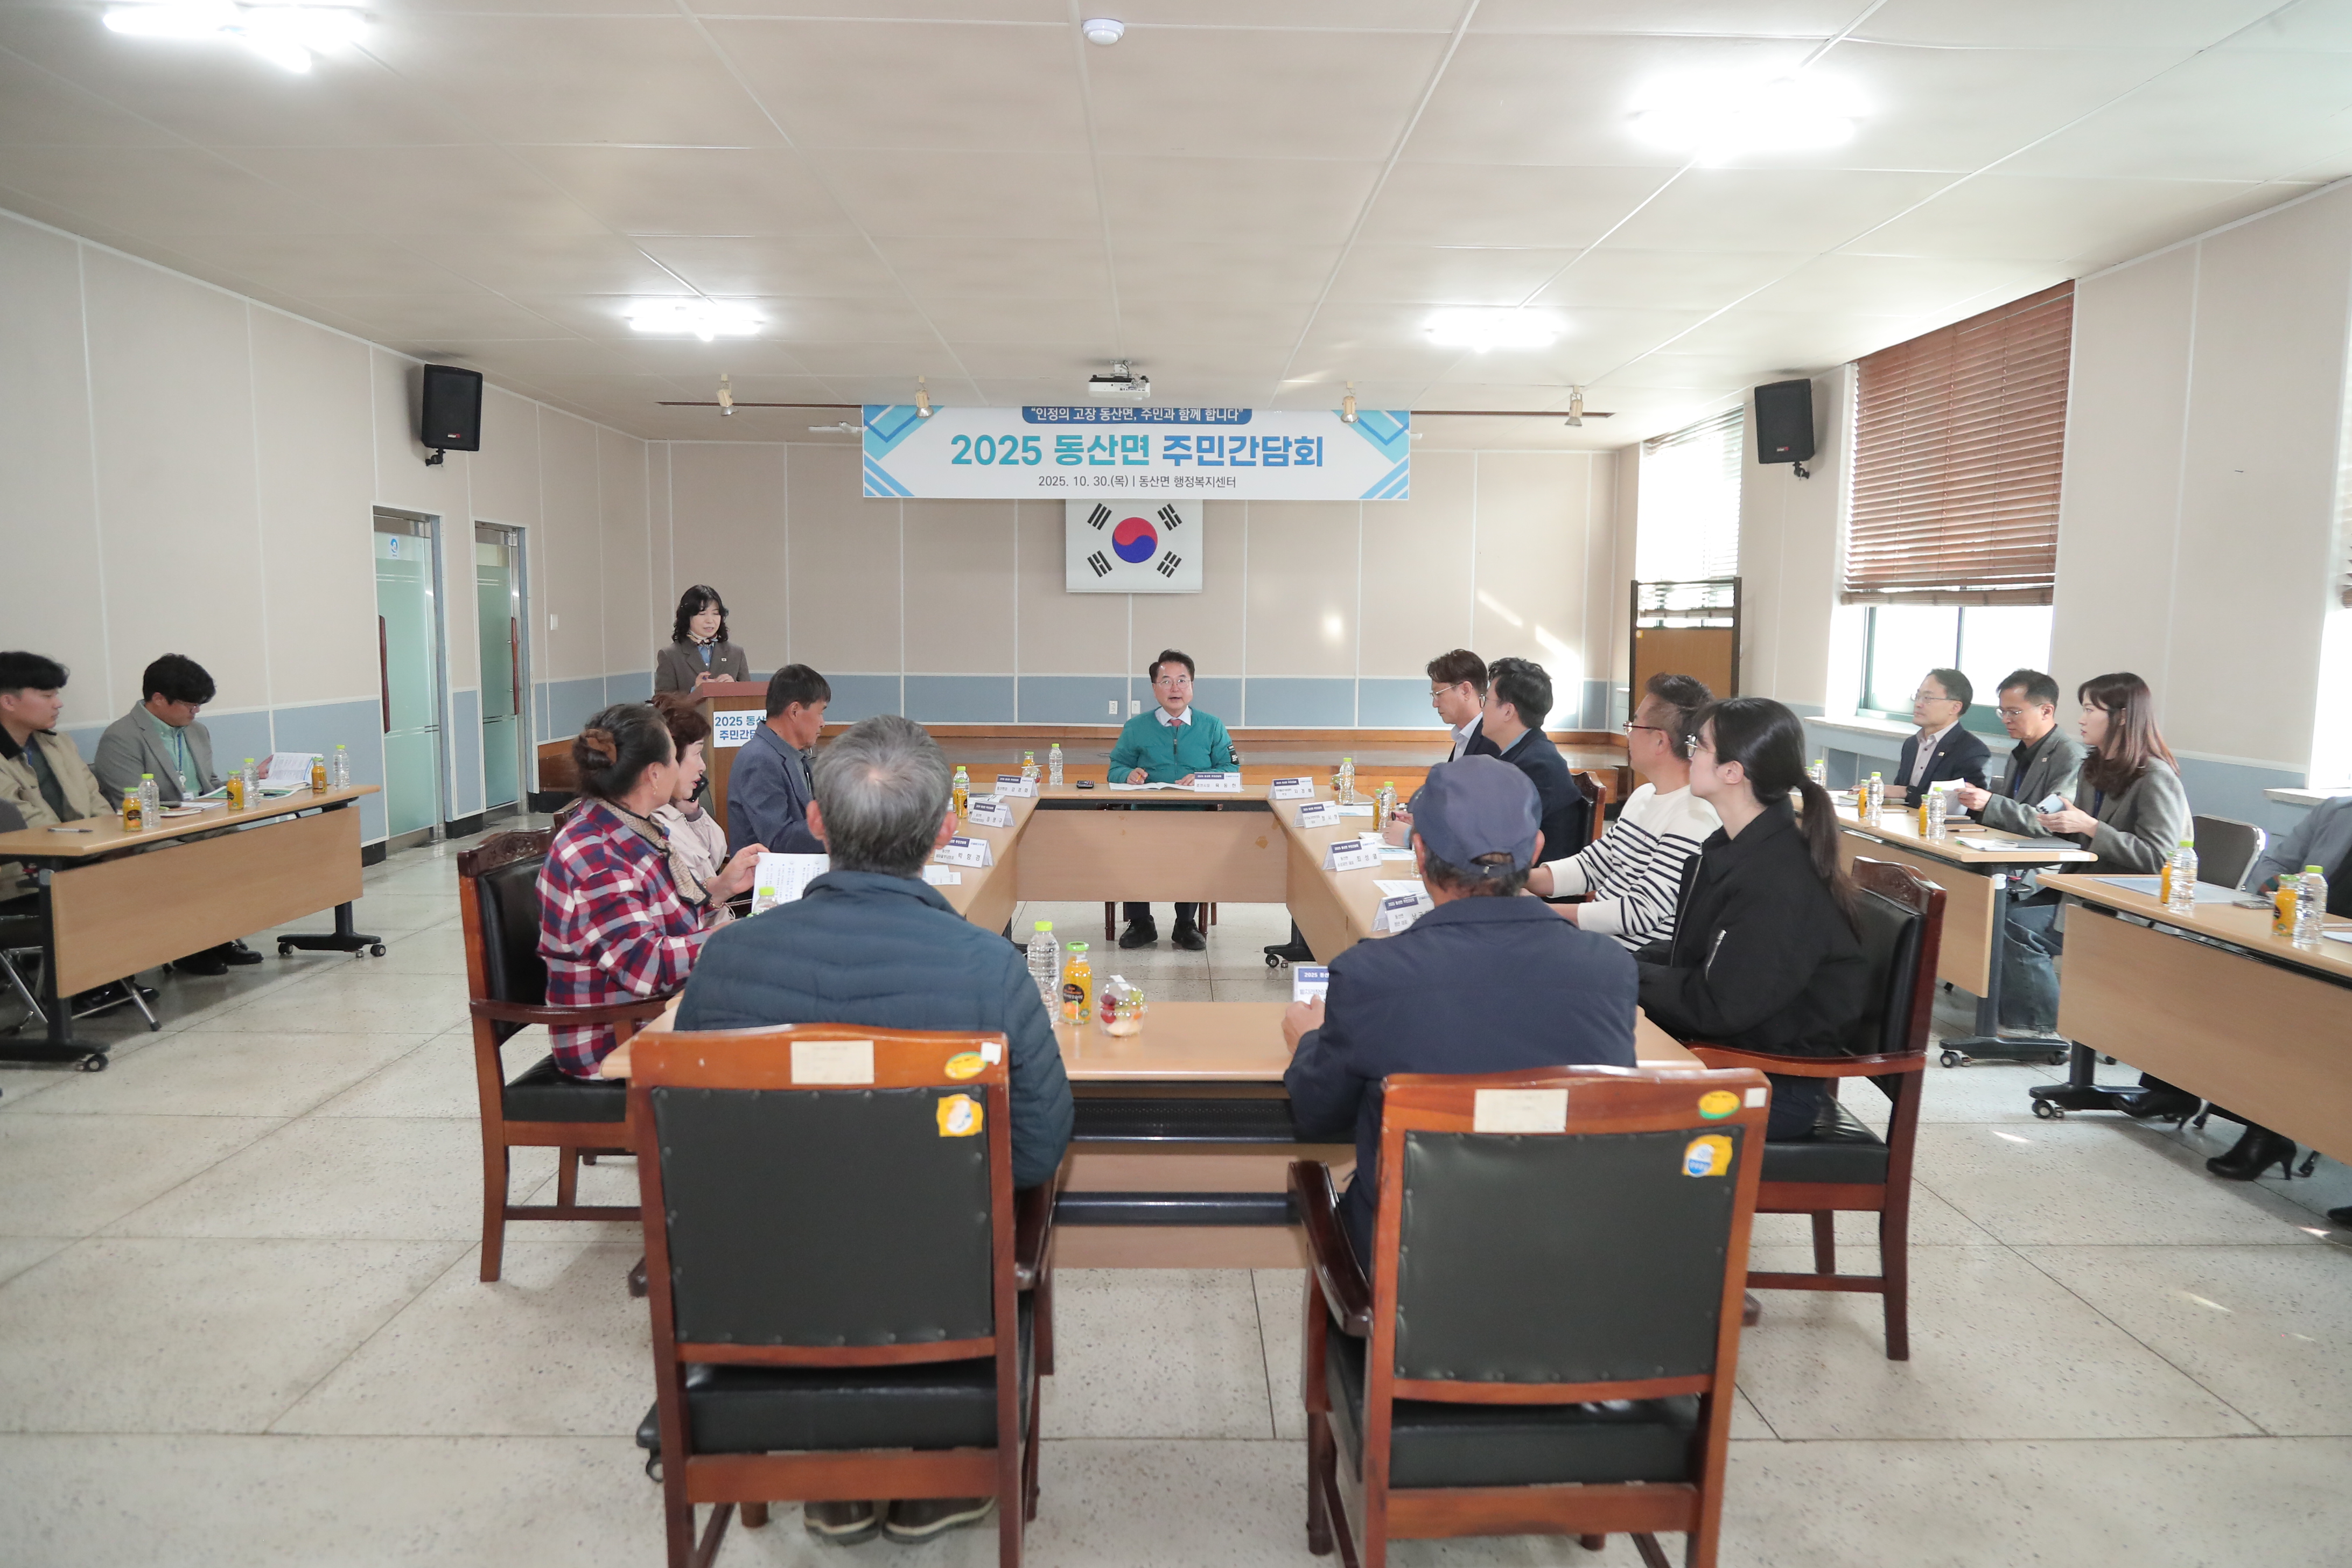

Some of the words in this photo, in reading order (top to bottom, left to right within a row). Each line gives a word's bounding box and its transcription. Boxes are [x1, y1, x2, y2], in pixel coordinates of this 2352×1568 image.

[1073, 408, 1096, 421] 고장
[1100, 408, 1137, 422] 동산면,
[1140, 408, 1175, 421] 주민과
[1179, 408, 1201, 421] 함께
[950, 434, 1042, 466] 2025
[1054, 434, 1150, 466] 동산면
[1162, 435, 1323, 467] 주민간담회
[1038, 475, 1069, 487] 2025.
[1074, 475, 1089, 487] 10.
[1093, 475, 1129, 488] 30.(목)
[1138, 475, 1170, 488] 동산면
[1173, 475, 1236, 488] 행정복지센터
[715, 716, 743, 726] 2025
[746, 716, 767, 726] 동산
